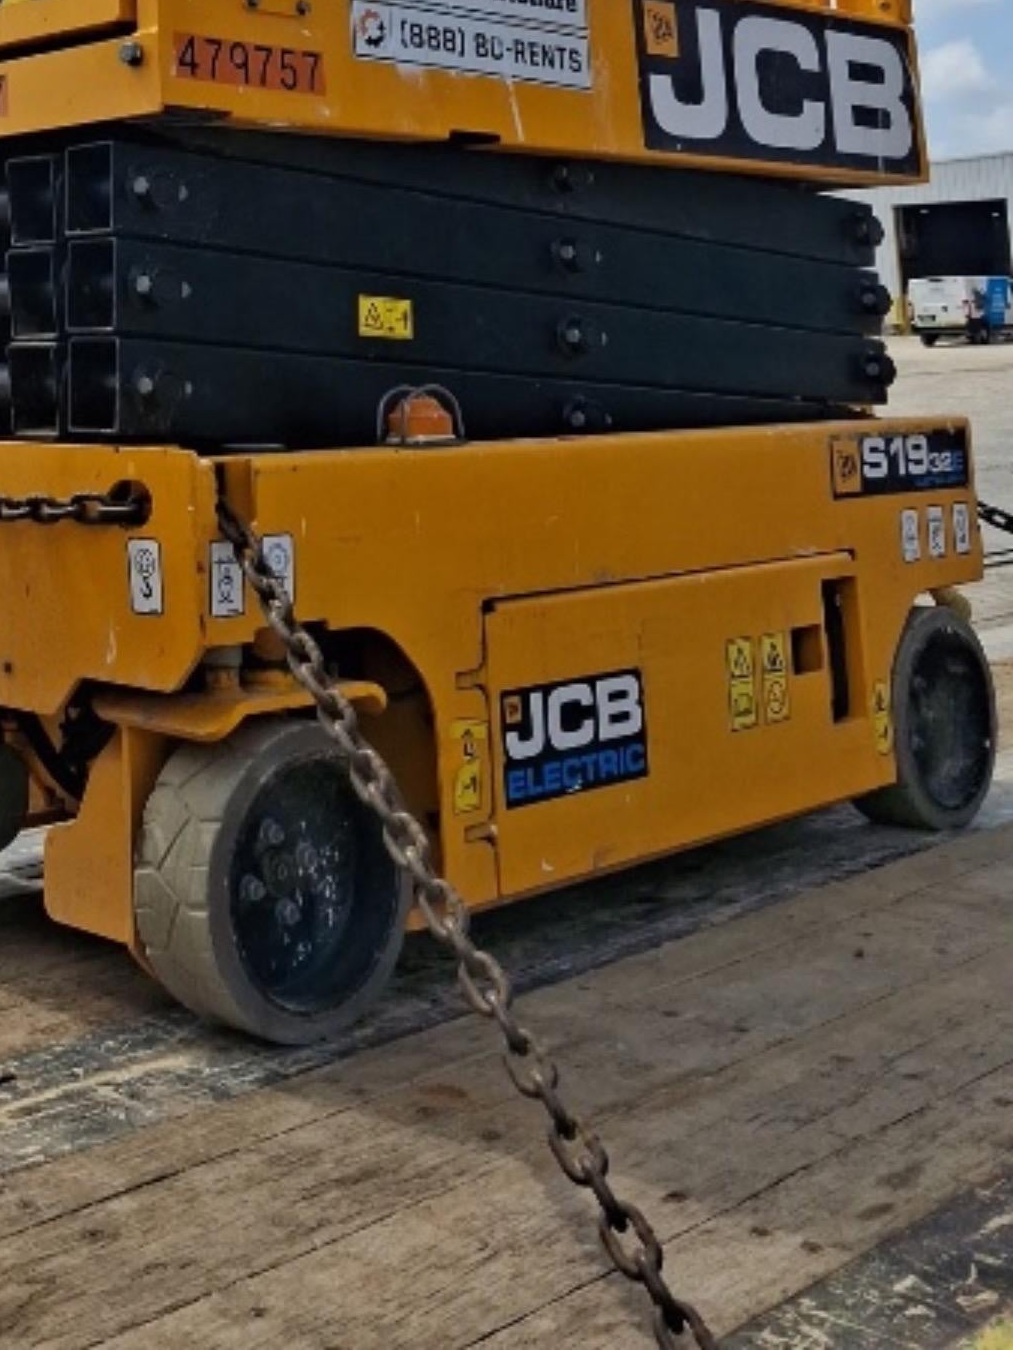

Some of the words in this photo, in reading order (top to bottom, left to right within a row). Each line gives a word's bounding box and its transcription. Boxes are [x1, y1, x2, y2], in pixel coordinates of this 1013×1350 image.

[179, 34, 321, 91] 479757
[400, 19, 466, 58] (888)
[649, 6, 913, 158] JCB
[505, 674, 642, 760] JCB
[507, 743, 645, 800] ELECTRIC
